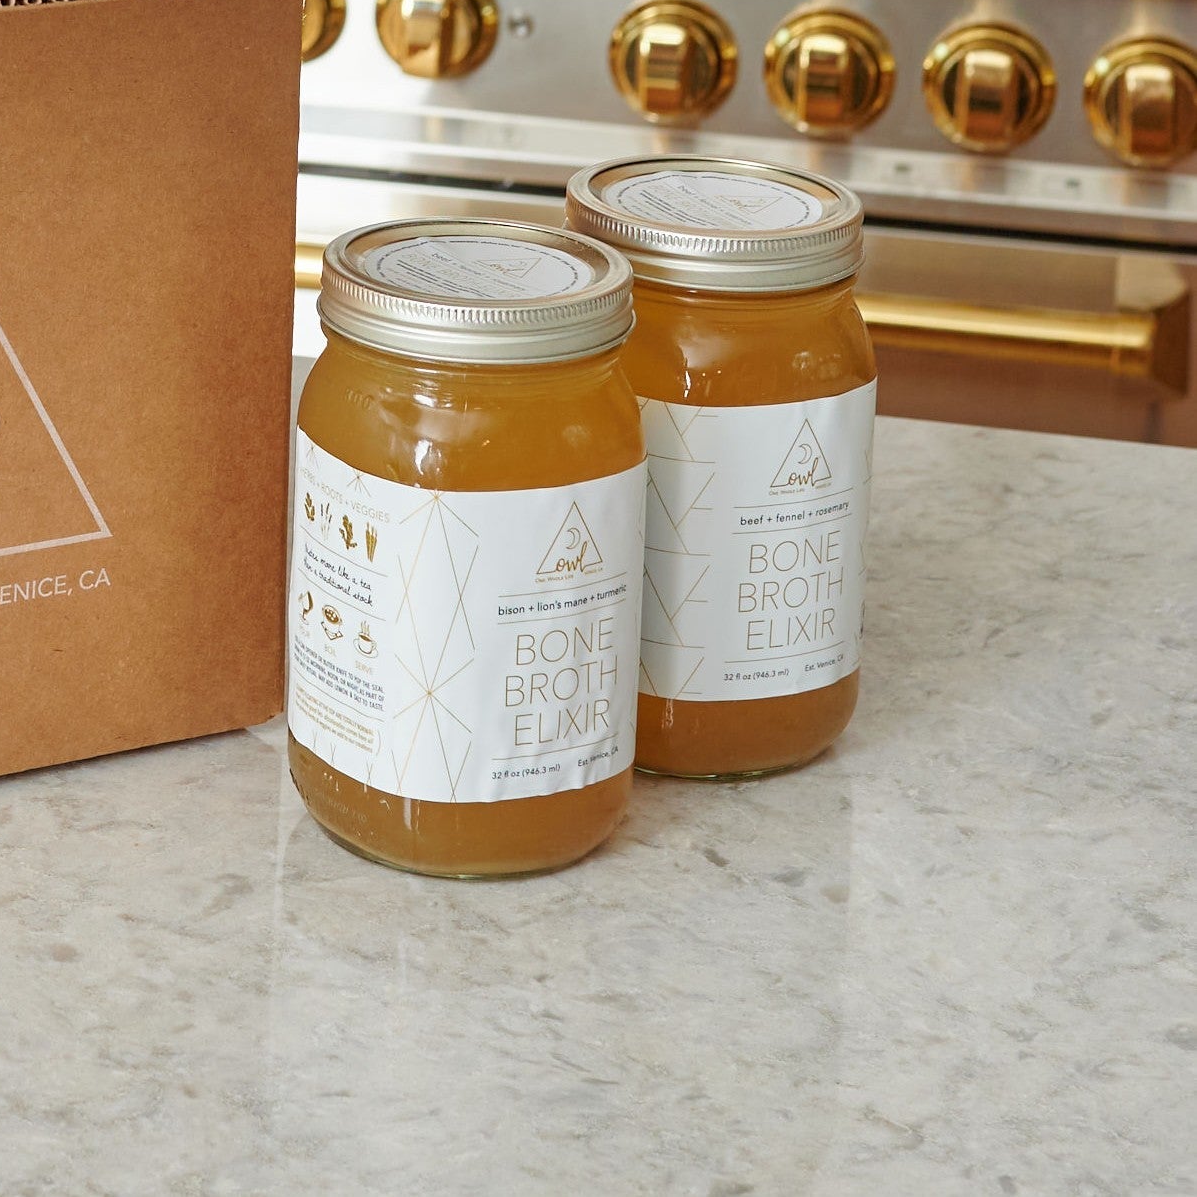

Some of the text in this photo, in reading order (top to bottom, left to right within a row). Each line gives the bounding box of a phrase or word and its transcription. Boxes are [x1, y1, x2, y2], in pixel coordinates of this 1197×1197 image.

[788, 457, 819, 487] owl
[350, 500, 391, 523] VEGGIES
[740, 514, 764, 526] beef
[776, 511, 805, 523] fennel
[815, 501, 850, 517] rosemary
[555, 541, 588, 573] owl
[749, 530, 841, 574] BONE
[79, 568, 111, 591] CA
[318, 570, 351, 596] traditional
[353, 592, 373, 608] stock
[321, 558, 337, 573] more
[338, 565, 350, 580] like
[360, 578, 372, 591] tea
[737, 566, 844, 613] BROTH
[498, 605, 526, 617] bison
[537, 600, 562, 612] lion's
[564, 597, 588, 608] mane
[516, 617, 614, 666] BONE
[746, 607, 835, 651] ELIXIR
[505, 655, 619, 707] BROTH
[723, 673, 734, 681] 32
[752, 670, 776, 680] (946.3
[777, 669, 790, 677] ml)
[365, 690, 377, 700] PART
[514, 698, 610, 746] ELIXIR
[491, 772, 502, 780] 32
[522, 767, 547, 778] (946.3
[548, 763, 561, 773] ml)
